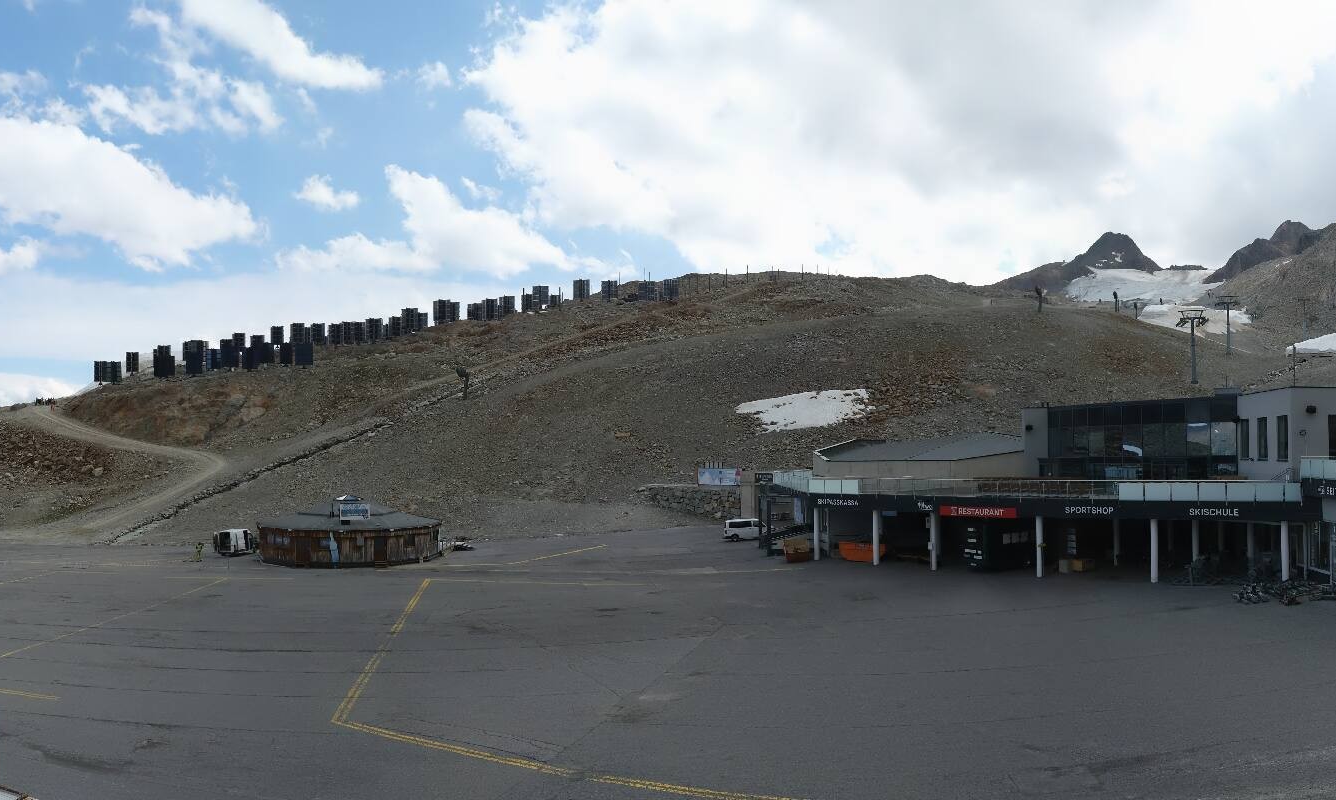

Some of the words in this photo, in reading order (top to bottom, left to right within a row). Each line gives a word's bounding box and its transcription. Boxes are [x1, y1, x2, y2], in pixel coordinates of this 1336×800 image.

[958, 507, 1005, 516] RESTAURANT
[1065, 506, 1114, 515] SPORTSHOP
[1188, 508, 1239, 516] SKISCHULE
